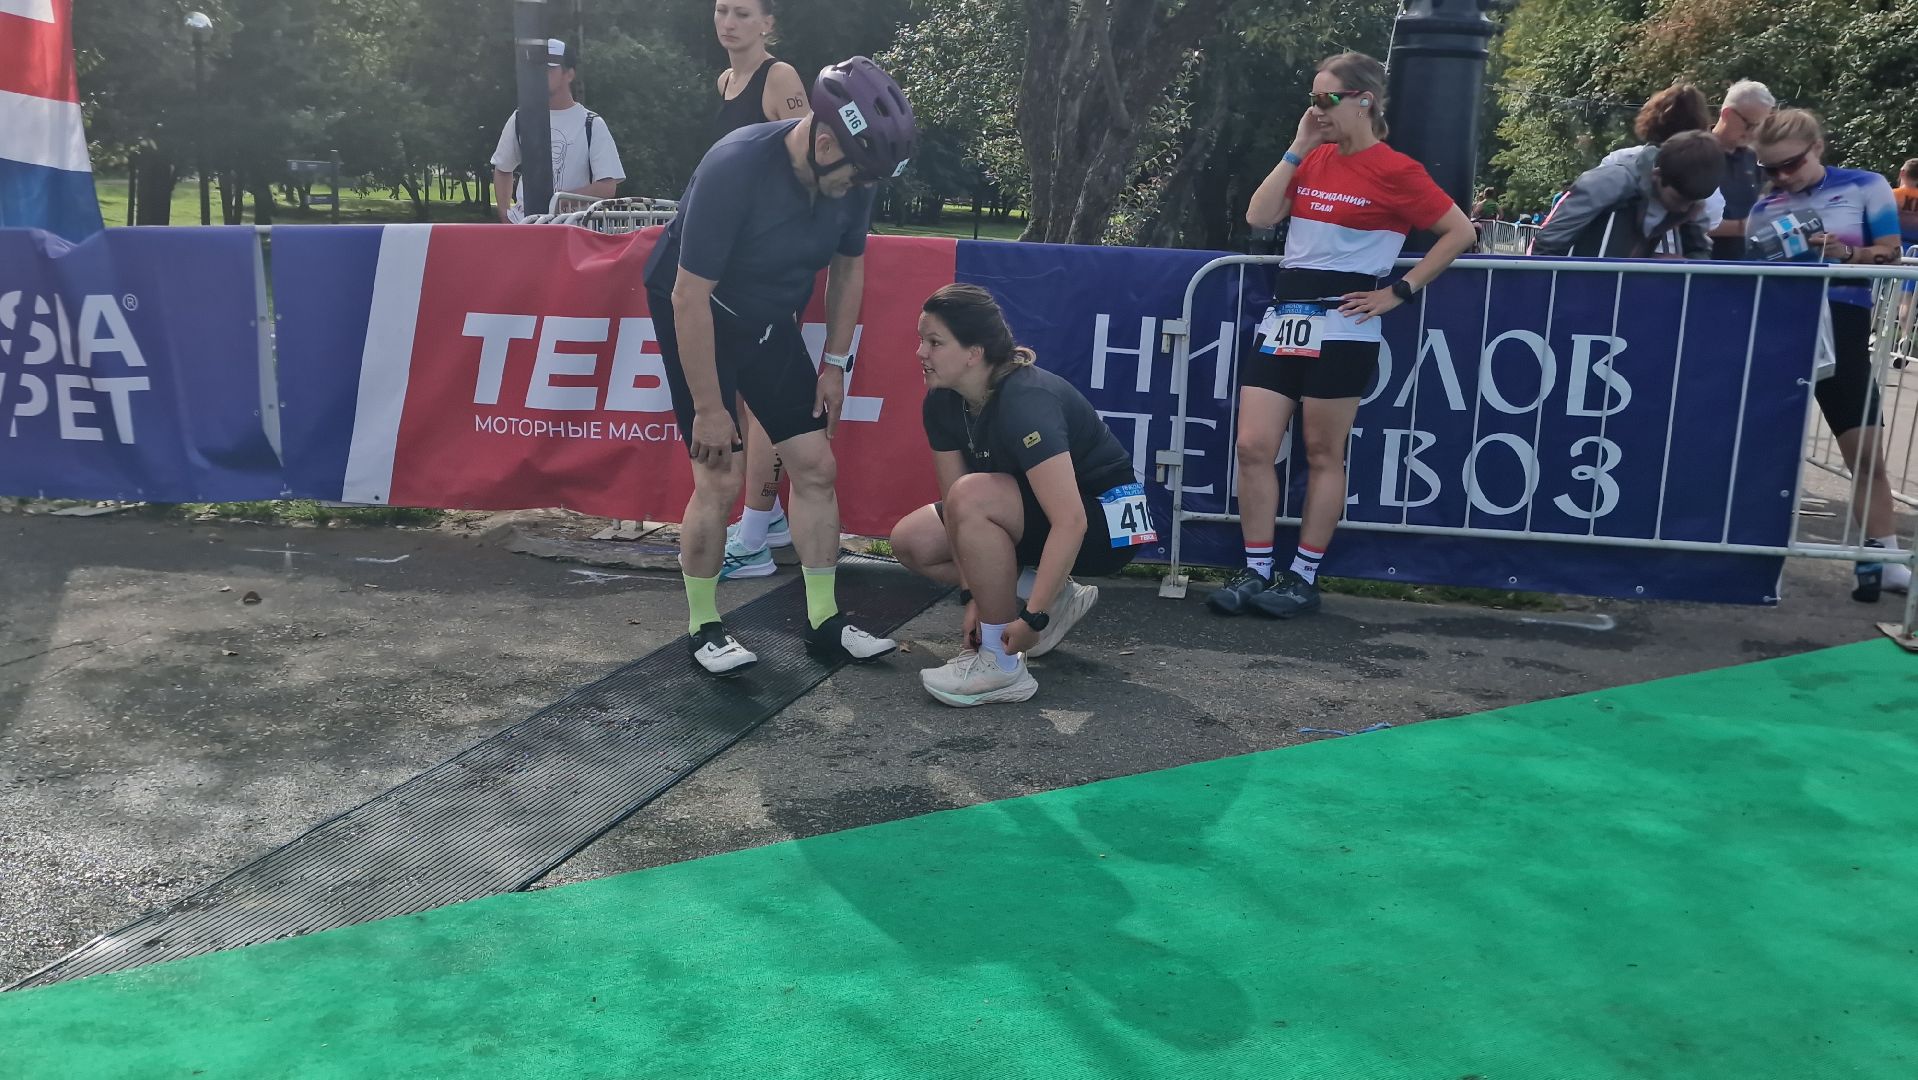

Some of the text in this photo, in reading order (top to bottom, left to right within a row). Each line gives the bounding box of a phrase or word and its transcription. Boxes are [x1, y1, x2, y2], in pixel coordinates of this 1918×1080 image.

[844, 108, 862, 130] 416
[1310, 201, 1334, 213] TEAM
[1274, 318, 1312, 347] 410
[475, 414, 683, 442] МОТОРНЫЕ МАСЛ
